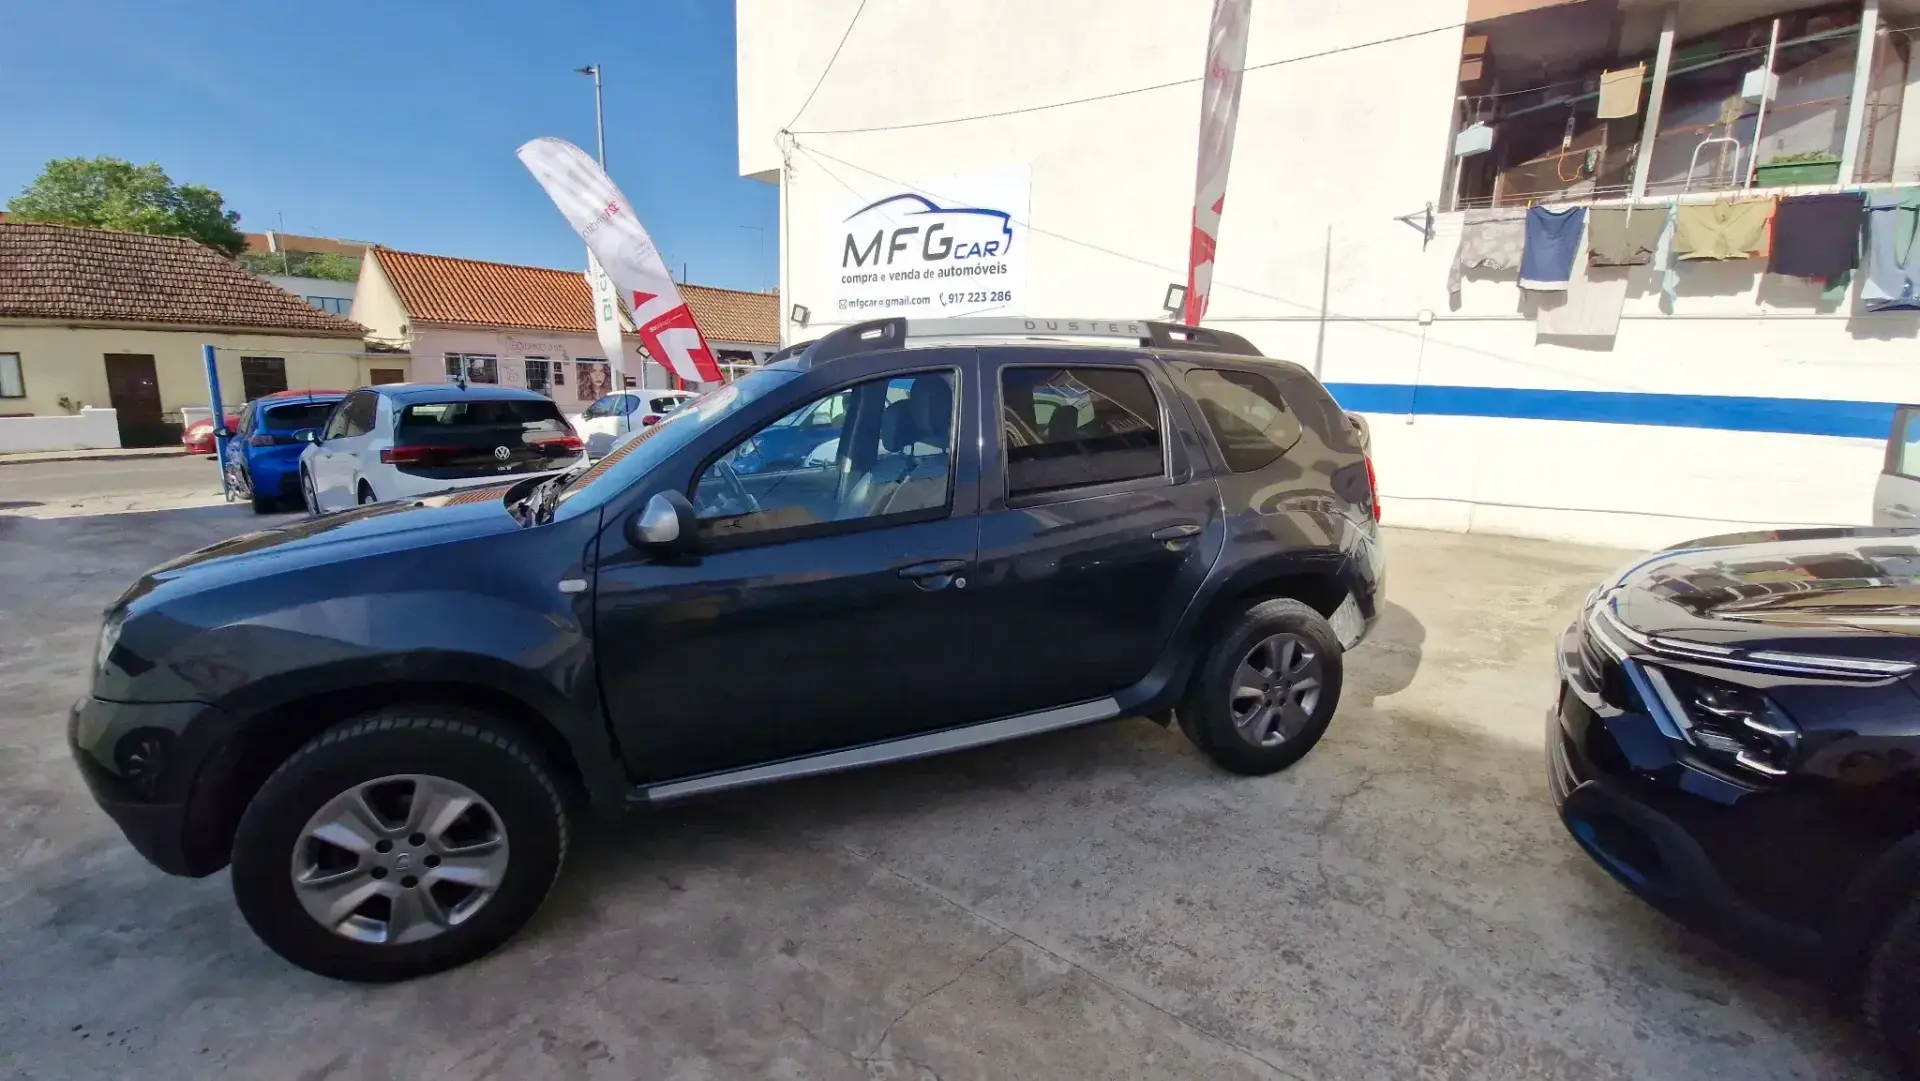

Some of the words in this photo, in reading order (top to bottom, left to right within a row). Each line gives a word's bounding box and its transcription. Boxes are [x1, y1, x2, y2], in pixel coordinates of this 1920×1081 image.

[842, 222, 954, 268] MFG
[954, 240, 1000, 260] CAR
[841, 273, 878, 285] compra
[880, 274, 886, 282] e
[889, 268, 921, 281] venda
[923, 268, 935, 279] de
[937, 262, 1008, 278] automóveis
[948, 292, 965, 304] 917
[967, 291, 987, 303] 223
[989, 290, 1012, 302] 286
[1024, 320, 1140, 334] DUSTER
